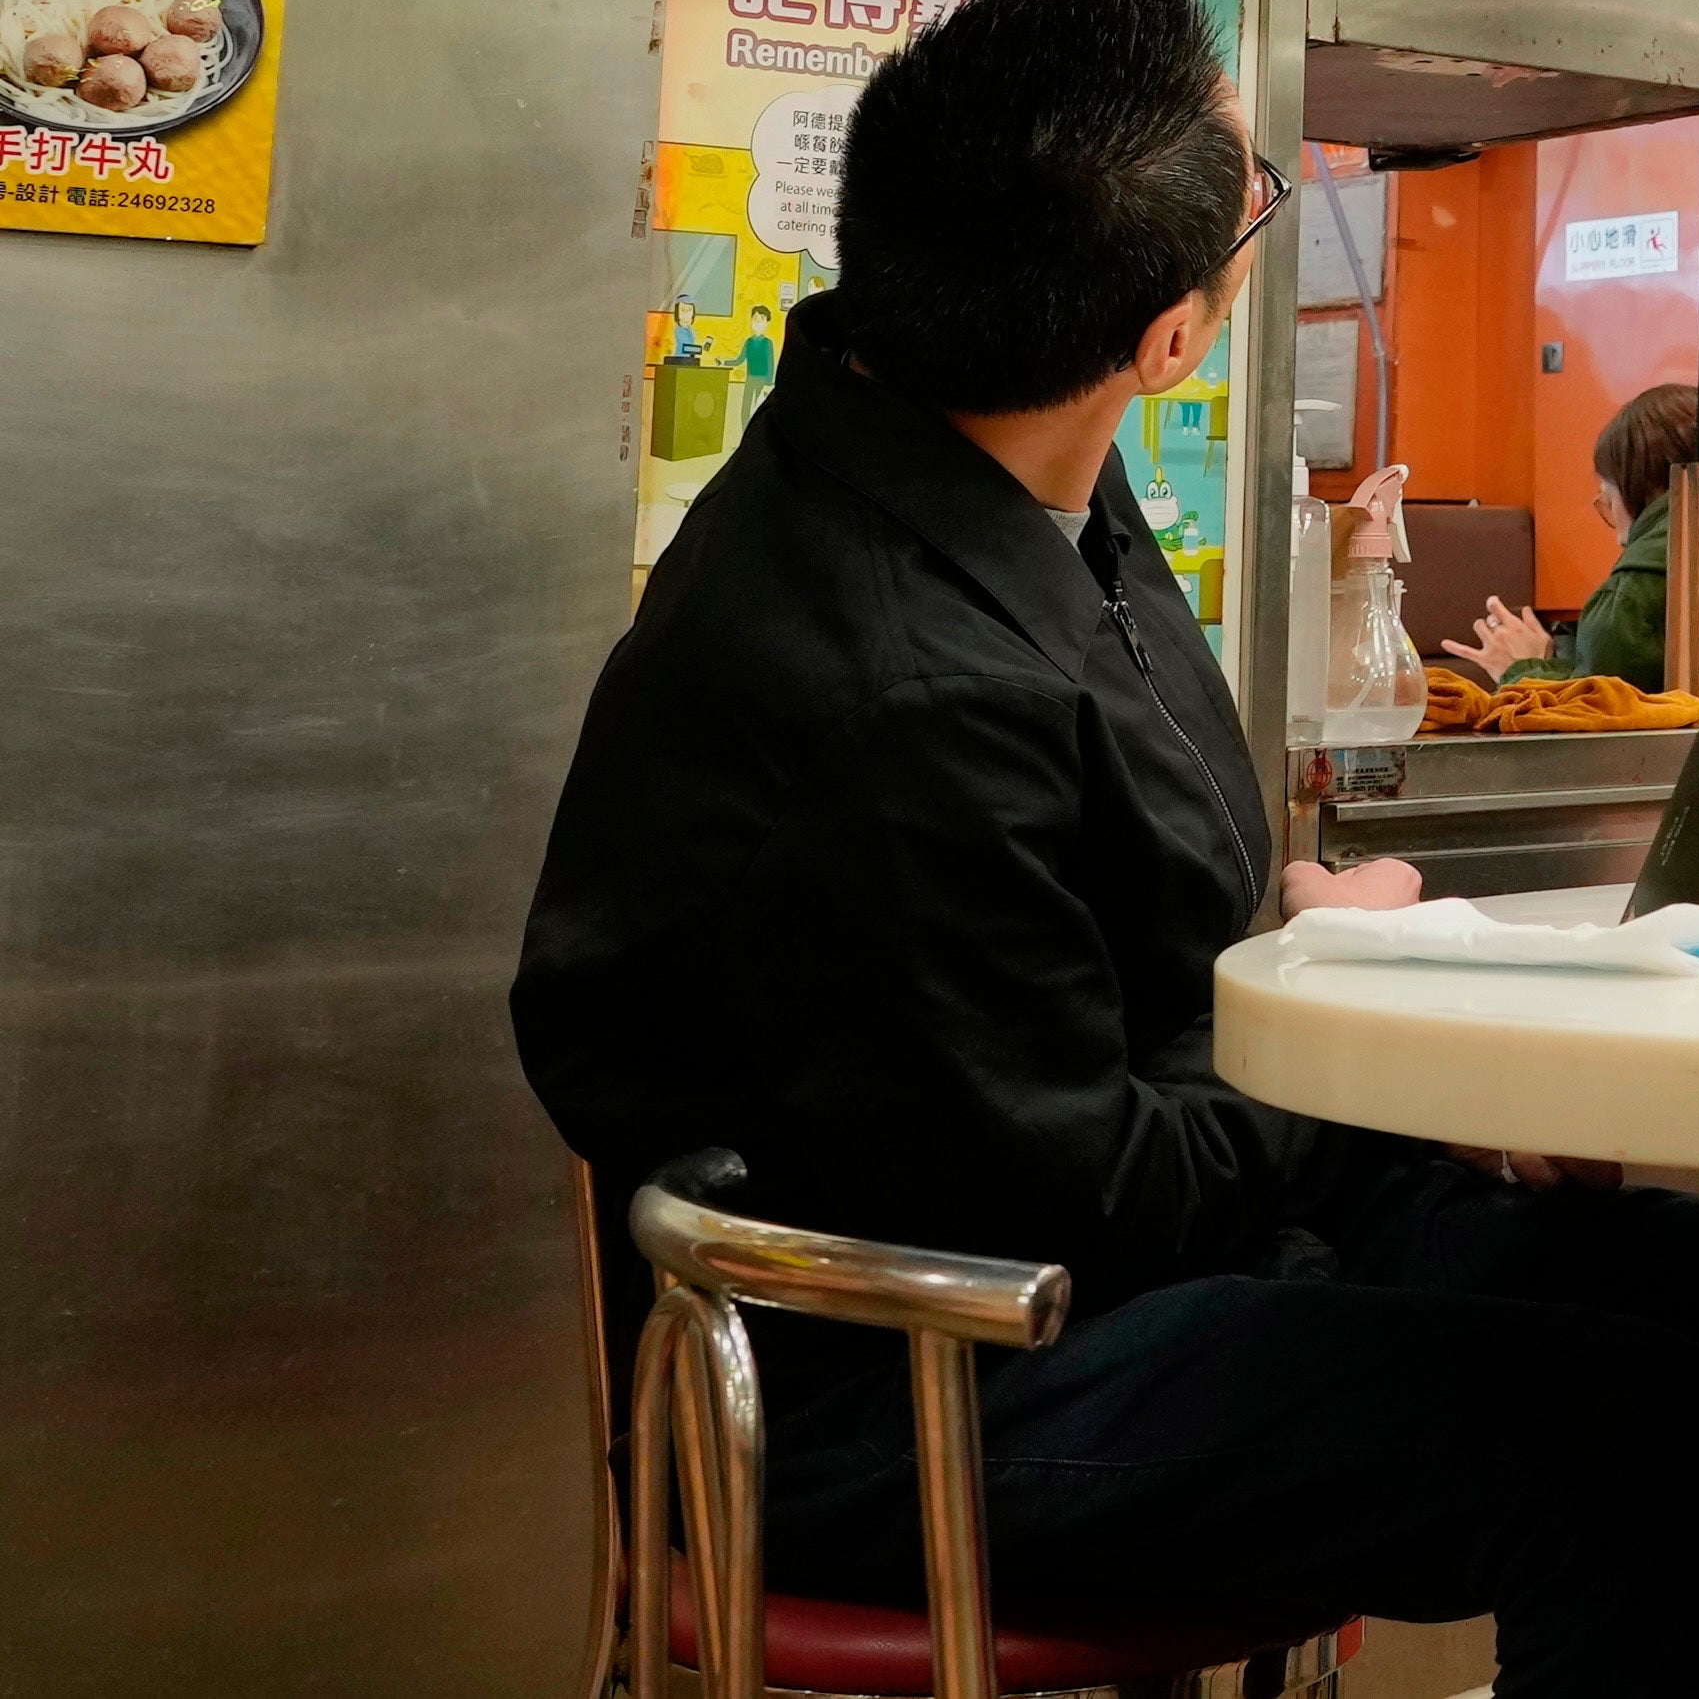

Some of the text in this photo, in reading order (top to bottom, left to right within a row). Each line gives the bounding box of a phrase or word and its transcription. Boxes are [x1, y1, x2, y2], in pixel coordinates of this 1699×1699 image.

[775, 180, 814, 197] Please
[66, 186, 216, 214] 電話:24692328
[781, 202, 793, 213] at
[795, 202, 809, 213] all
[777, 219, 826, 237] catering
[1570, 224, 1638, 253] 小心地滑
